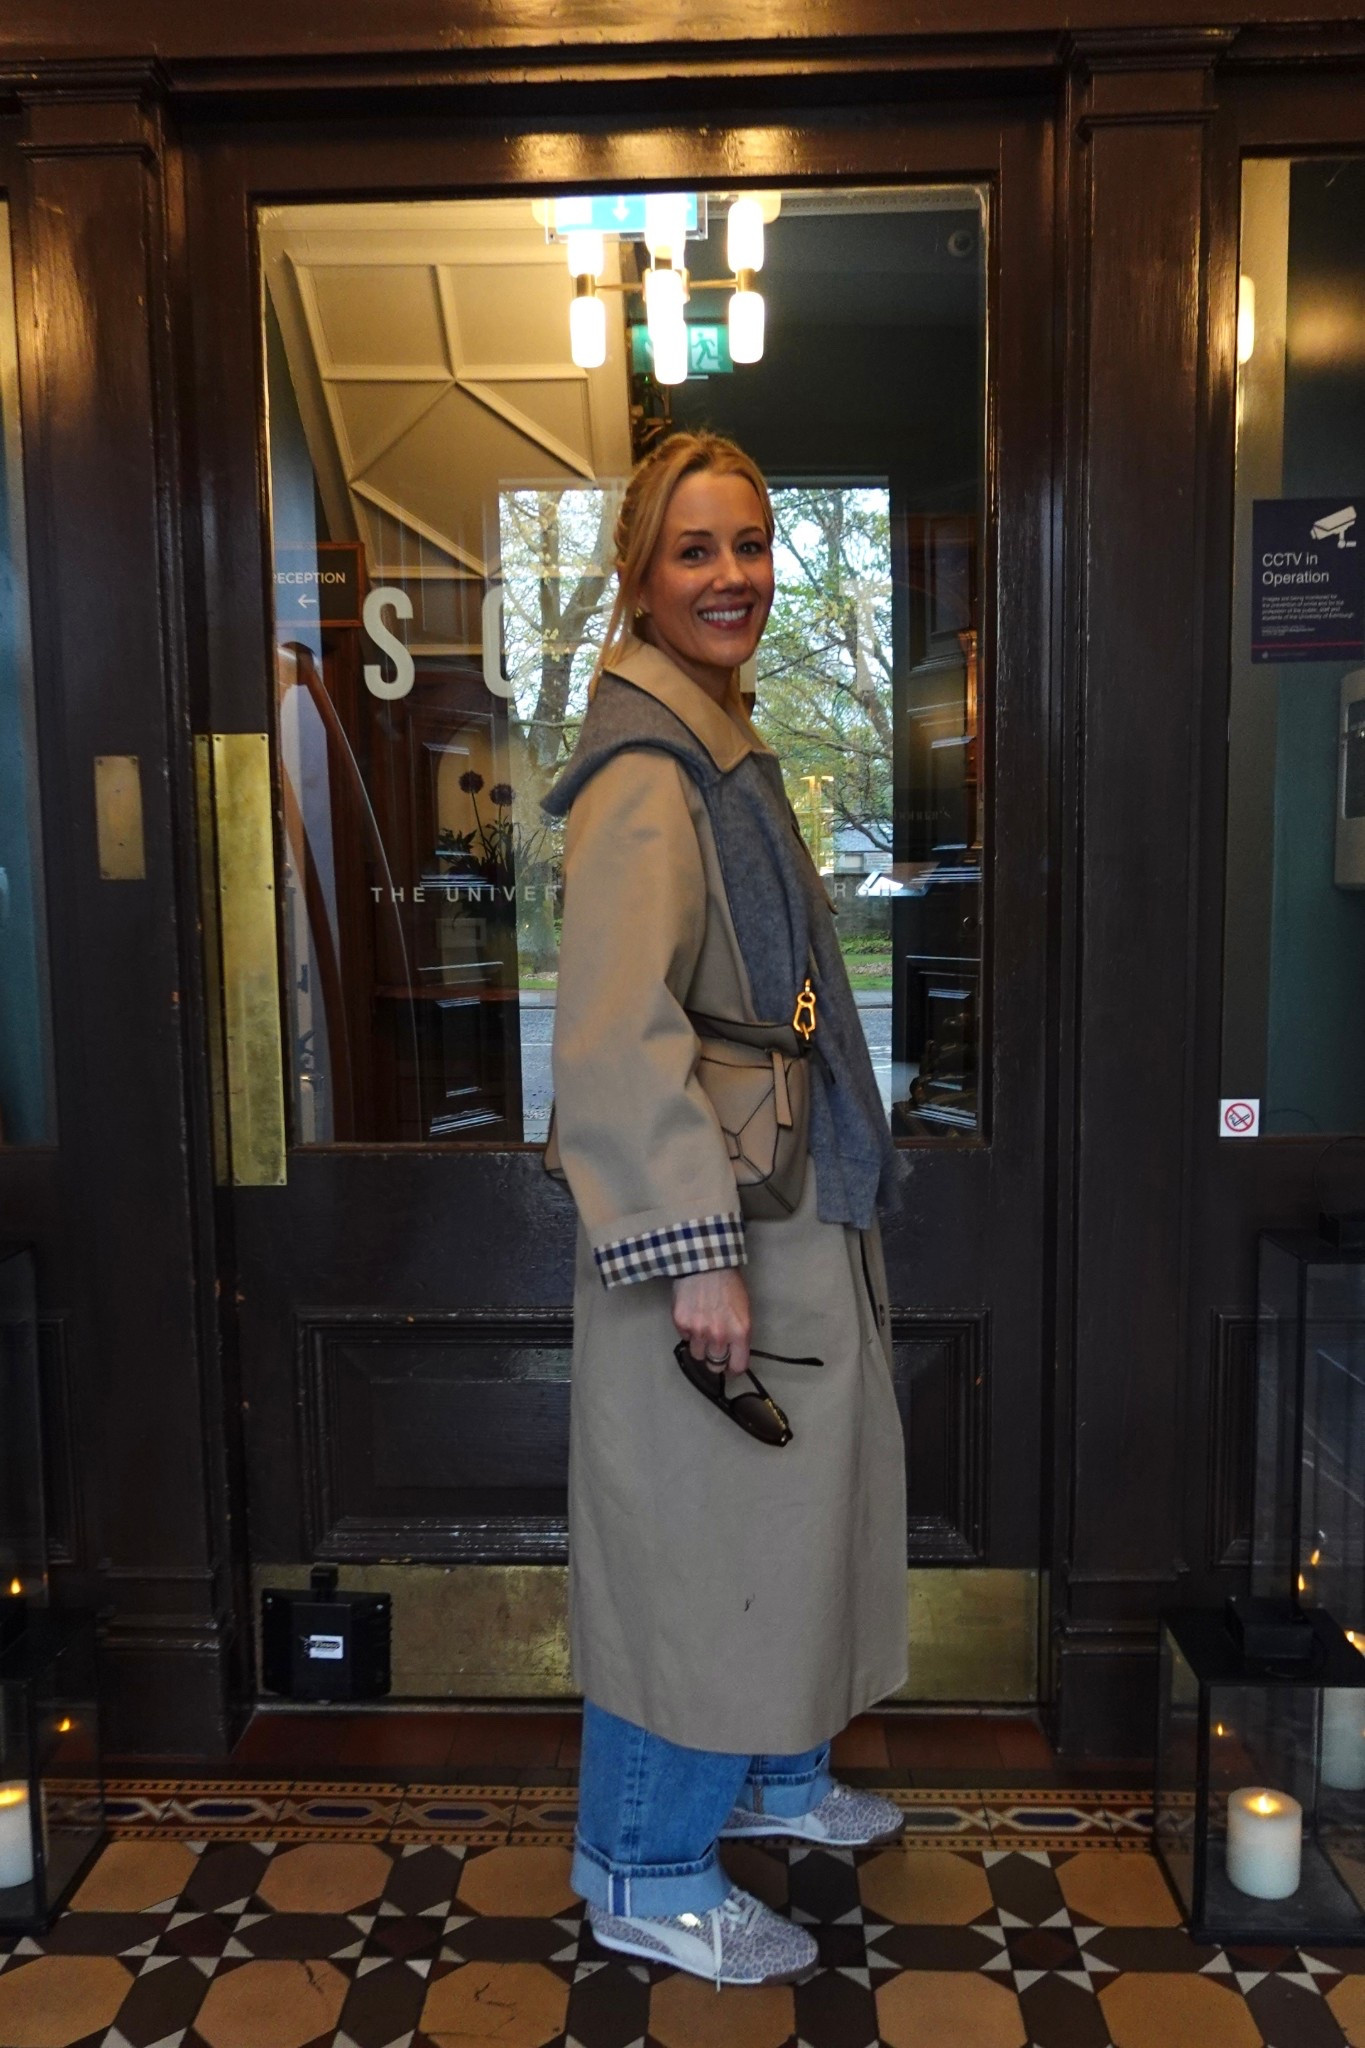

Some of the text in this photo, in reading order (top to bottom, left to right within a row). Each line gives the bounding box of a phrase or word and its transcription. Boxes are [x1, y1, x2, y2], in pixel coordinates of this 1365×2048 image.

[1262, 552, 1318, 567] CCTV in
[1262, 571, 1330, 588] Operation
[371, 886, 426, 903] THE
[446, 886, 559, 903] UNIVER
